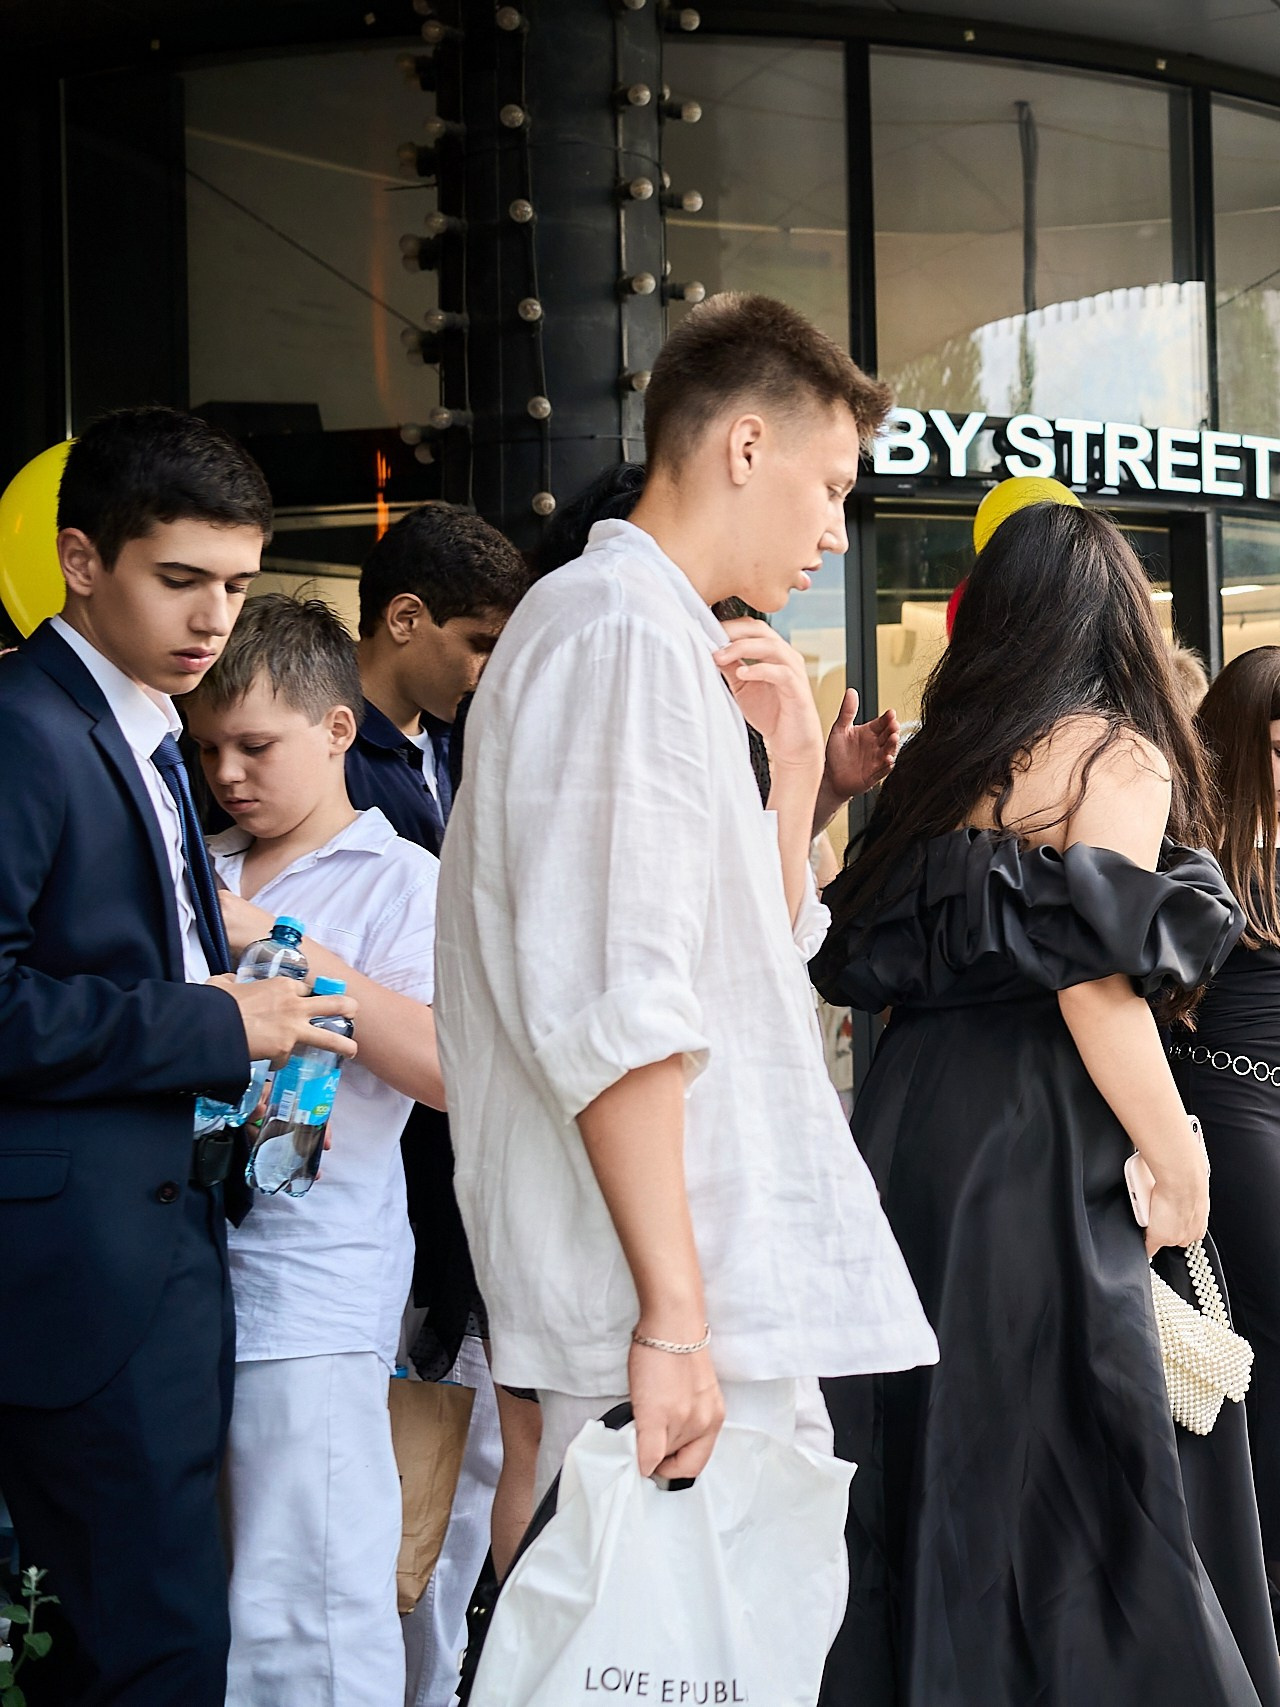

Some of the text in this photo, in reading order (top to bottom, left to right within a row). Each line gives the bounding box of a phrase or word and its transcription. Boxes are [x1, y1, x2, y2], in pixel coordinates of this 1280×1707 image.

[873, 407, 987, 477] BY
[585, 1666, 749, 1705] LOVE EPUBL
